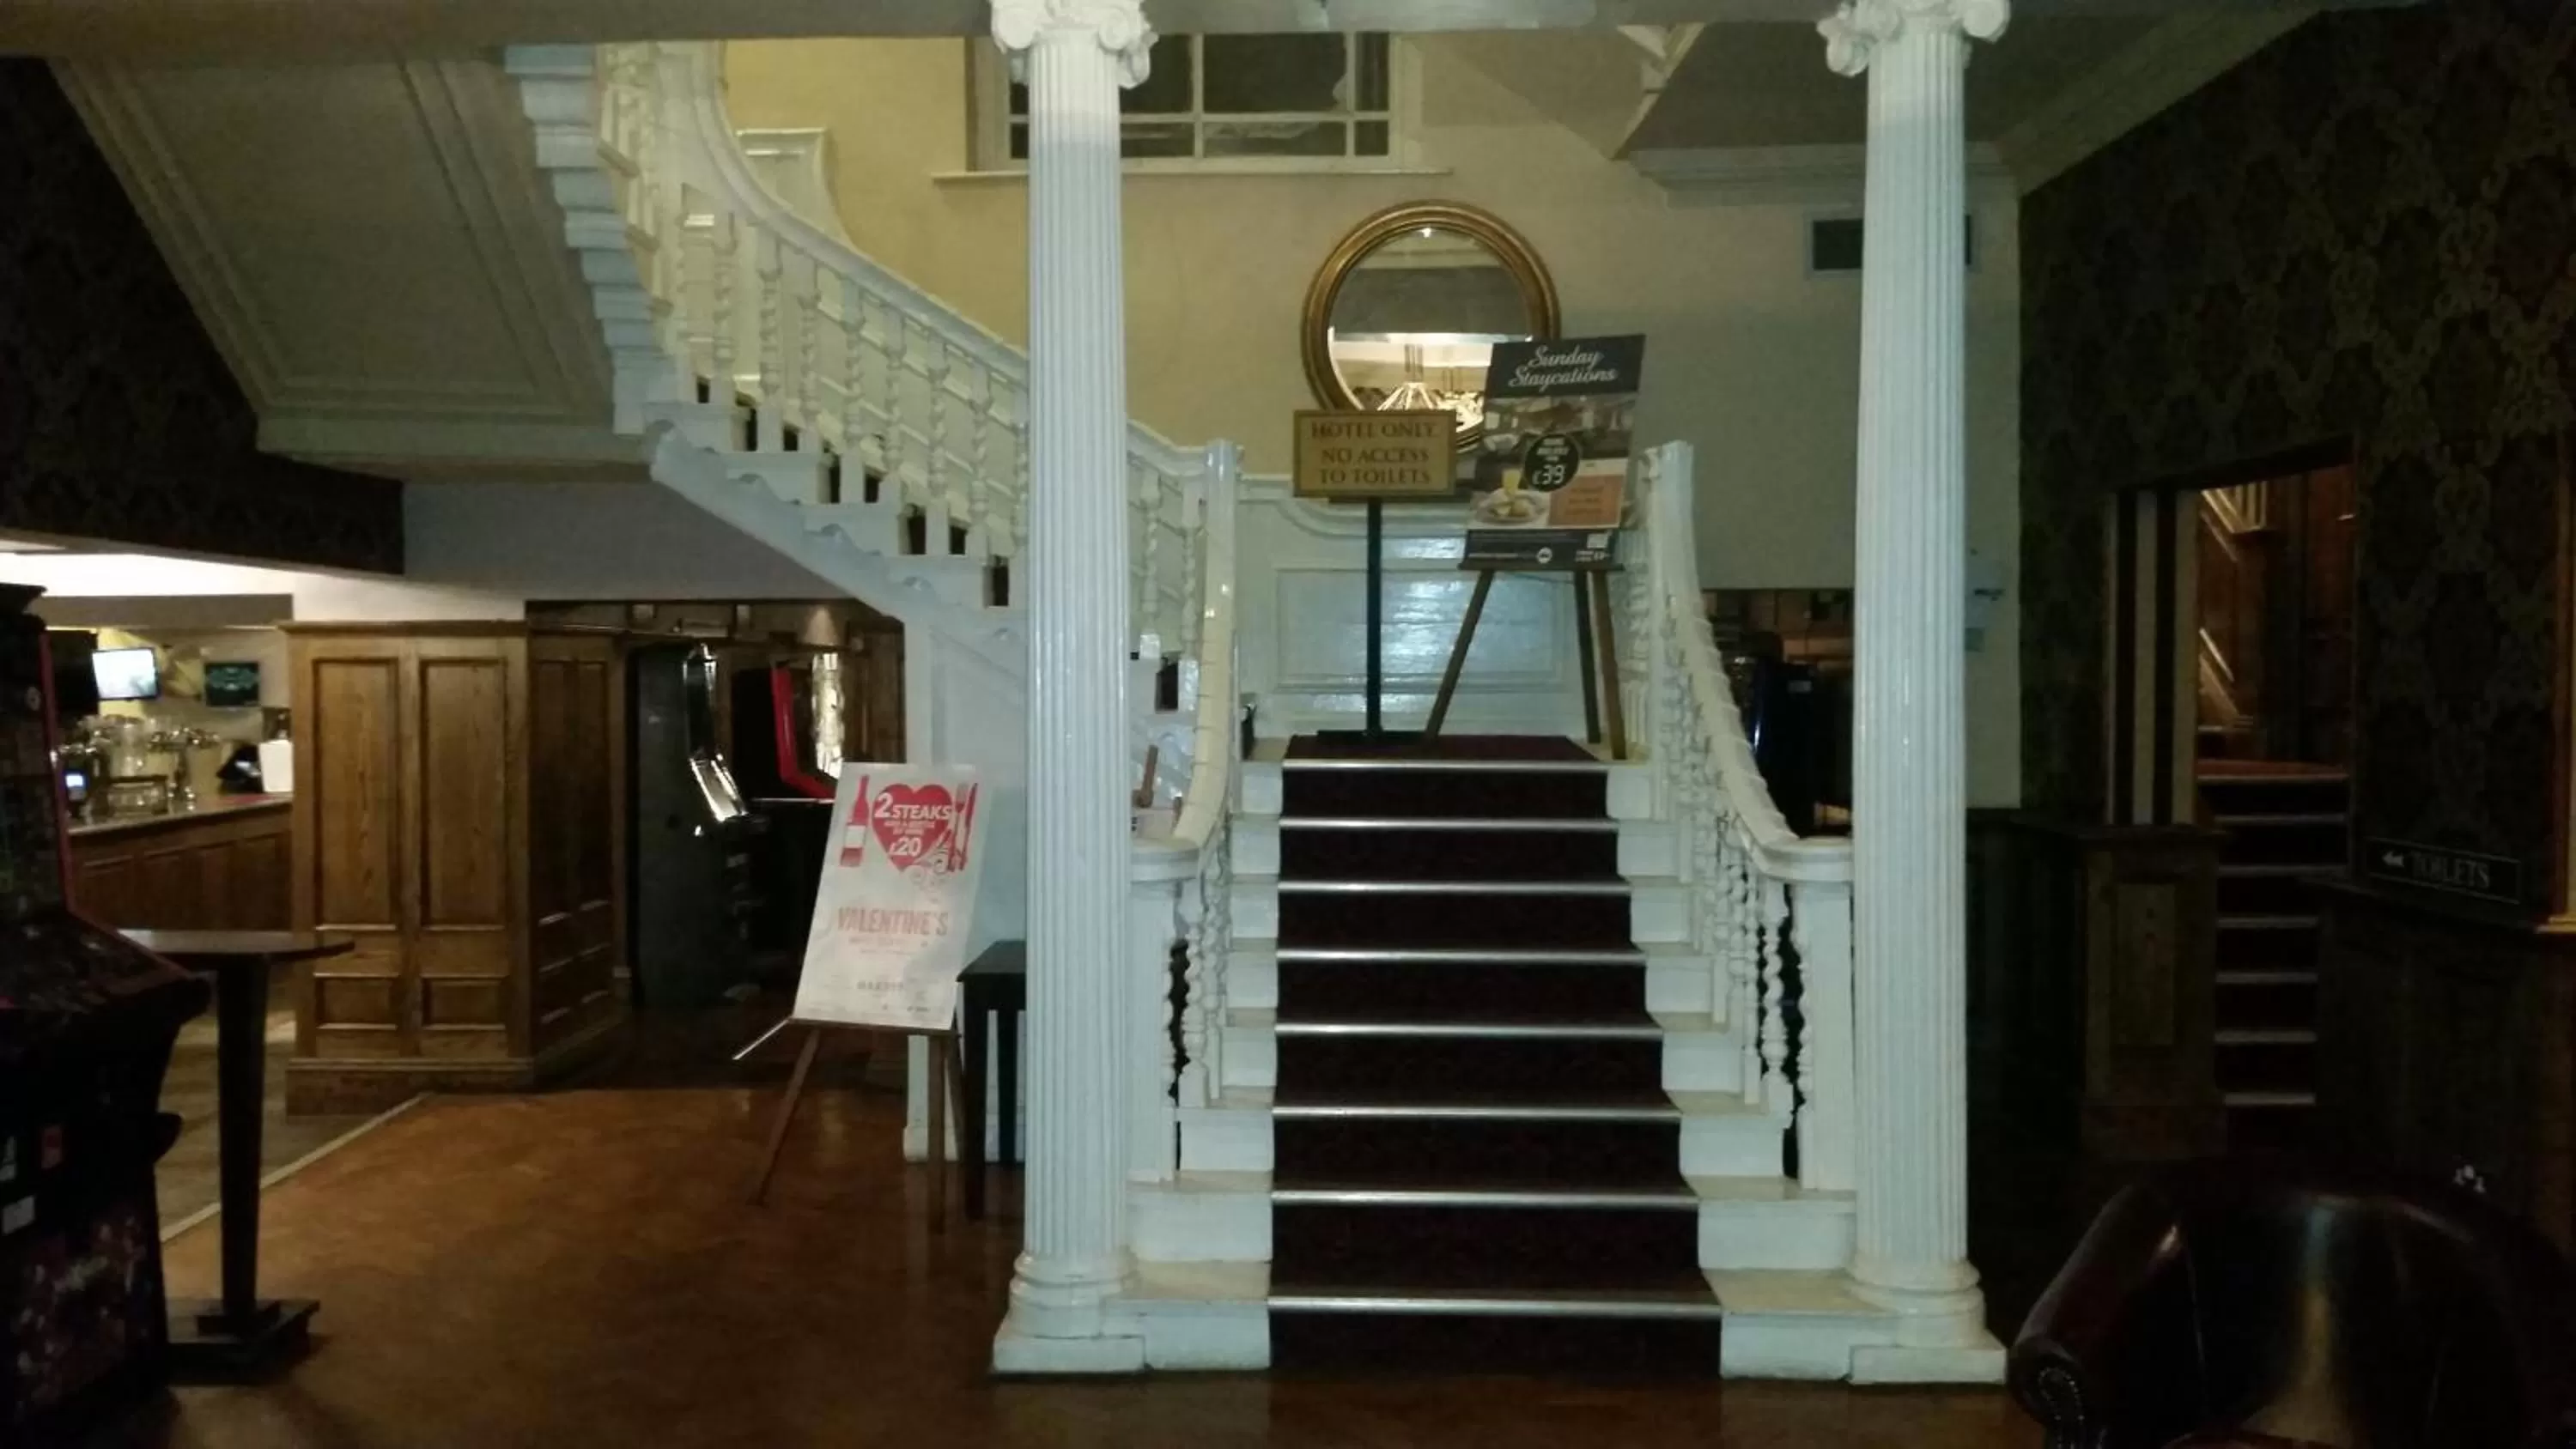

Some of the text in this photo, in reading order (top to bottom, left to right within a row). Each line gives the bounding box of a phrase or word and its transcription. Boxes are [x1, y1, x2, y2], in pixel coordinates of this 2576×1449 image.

[1528, 343, 1605, 371] Sunday
[1508, 365, 1619, 393] Staycations
[1311, 421, 1438, 440] HOTEL ONLY
[1321, 447, 1430, 464] NO ACCESS
[1320, 467, 1431, 485] TO TOILETS
[1532, 464, 1565, 485] £39
[874, 792, 953, 820] 2 STEAKS
[889, 836, 921, 857] £20
[2410, 850, 2491, 890] TOILETS
[838, 906, 949, 937] VALENTINE'S
